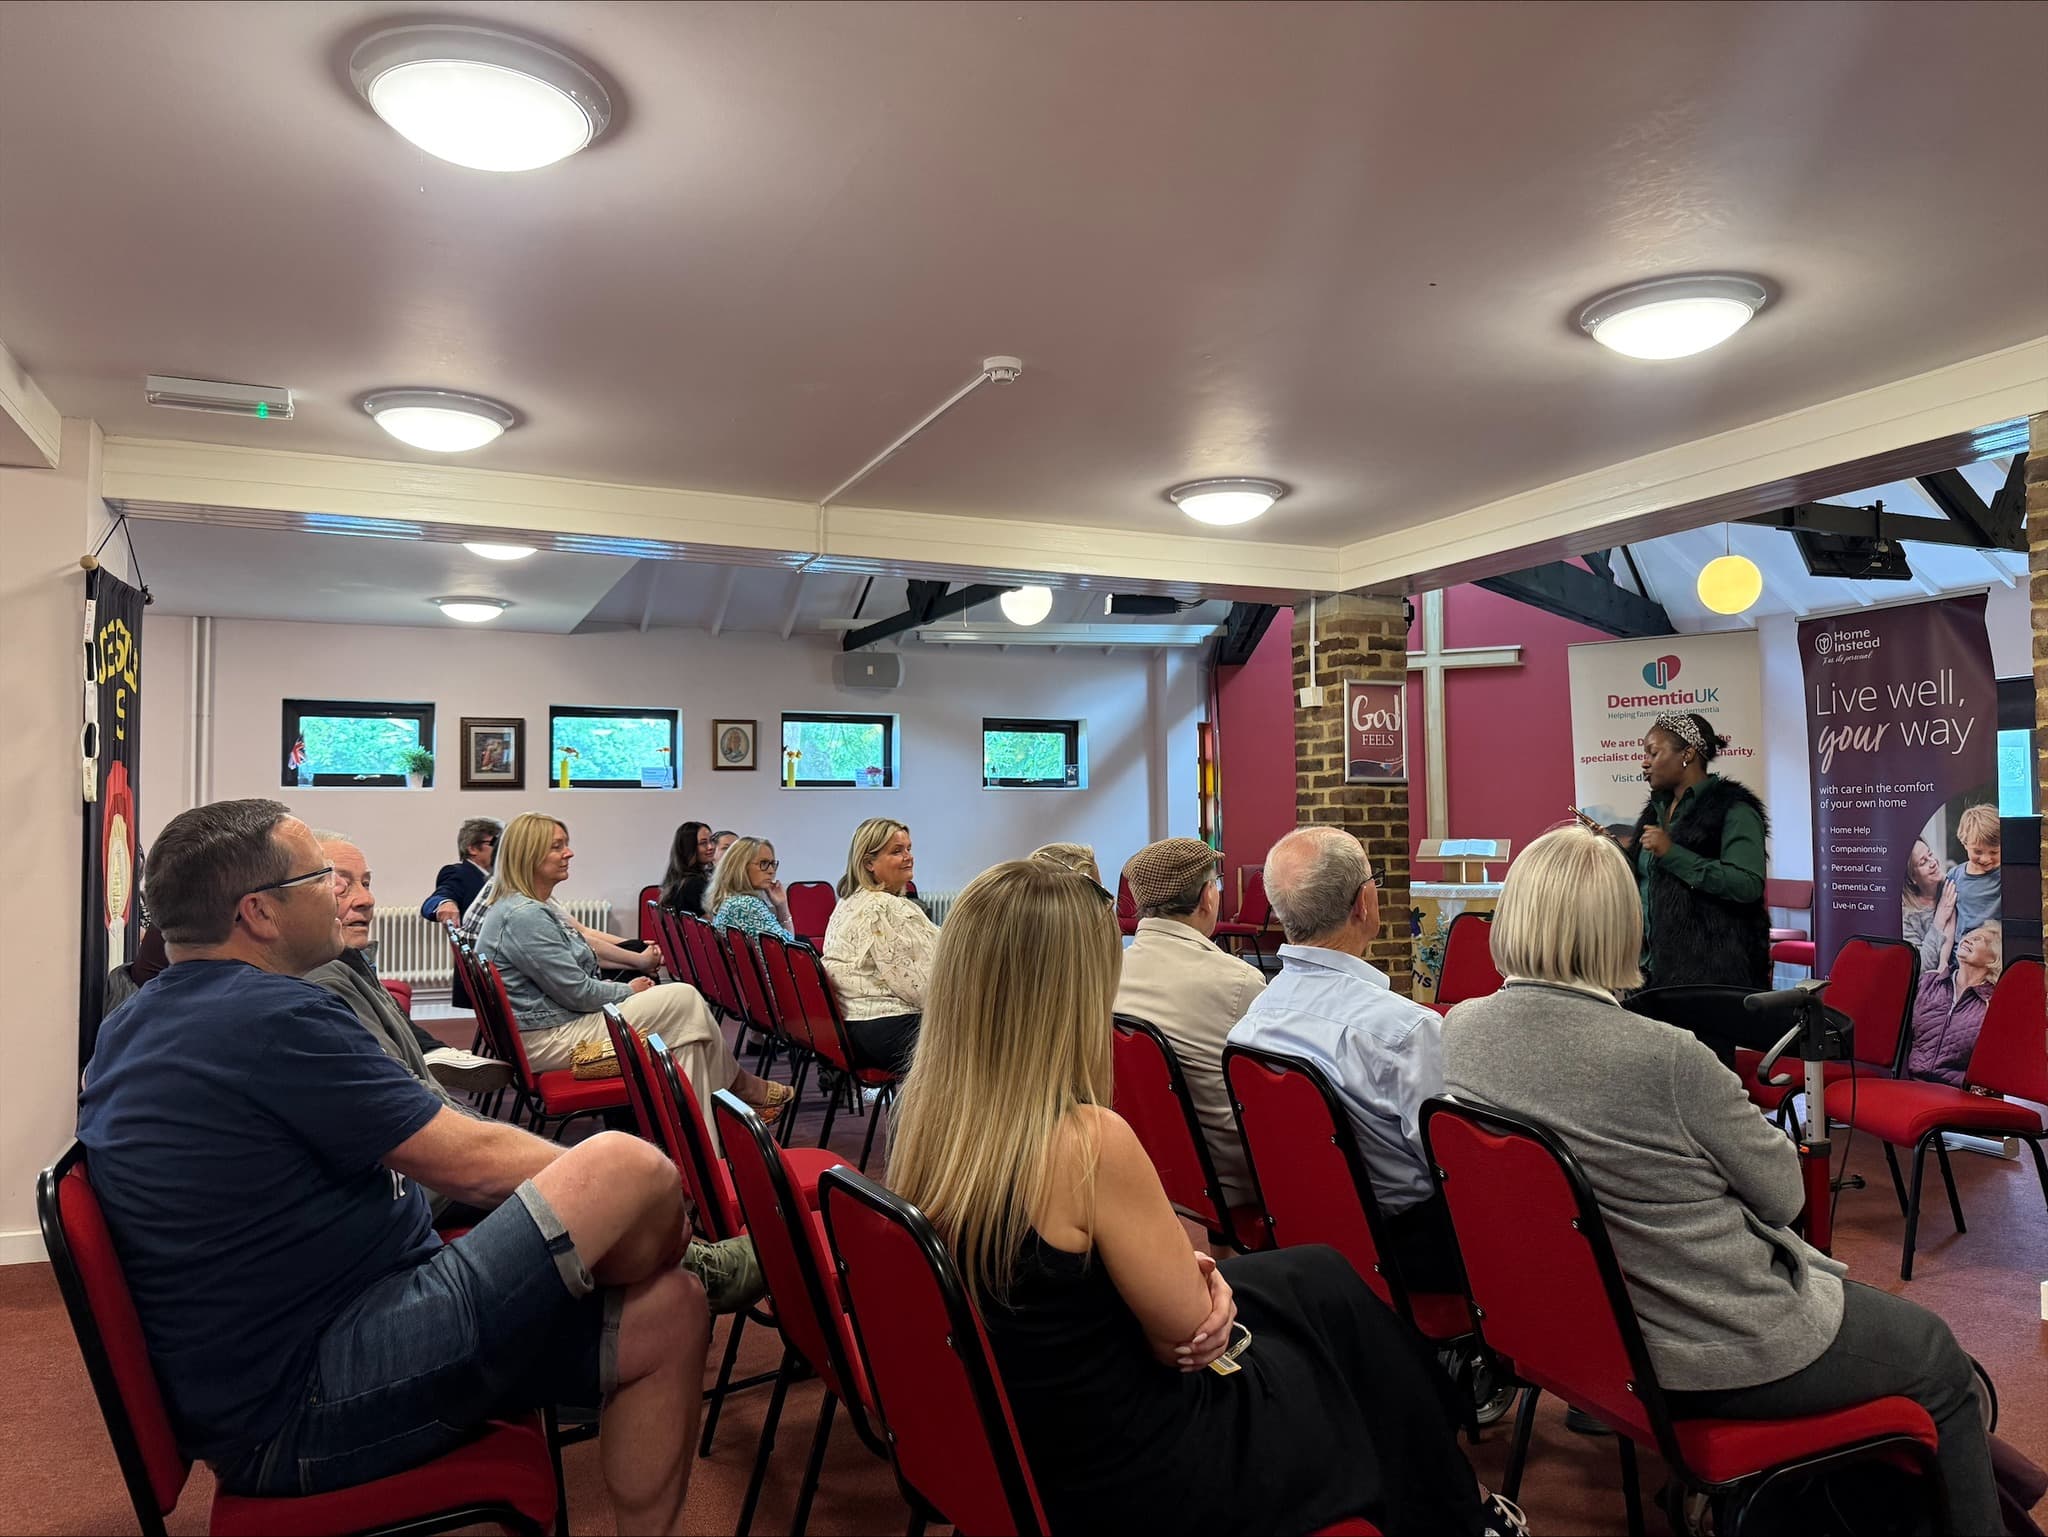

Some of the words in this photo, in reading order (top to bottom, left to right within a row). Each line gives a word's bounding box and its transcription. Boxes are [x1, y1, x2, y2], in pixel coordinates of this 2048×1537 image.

[1834, 629, 1871, 641] Home
[1834, 636, 1880, 653] Instead
[1815, 682, 1877, 716] Live
[1886, 668, 1965, 710] well,
[1352, 694, 1401, 731] God
[1608, 711, 1636, 720] Helping
[1684, 706, 1720, 715] dementia
[1362, 734, 1394, 746] FEELS
[1601, 739, 1617, 748] We
[1618, 740, 1635, 748] are
[1817, 720, 1890, 775] your
[1900, 716, 1975, 755] way
[1580, 752, 1630, 765] specialist
[1611, 773, 1634, 783] Visit
[1819, 784, 1838, 794] with
[1840, 785, 1862, 794] care
[1864, 784, 1874, 793] in
[1876, 783, 1891, 793] the
[1893, 782, 1934, 793] comfort
[1820, 798, 1829, 809] of
[1829, 799, 1854, 812] your
[1855, 799, 1876, 808] own
[1878, 797, 1907, 808] home
[1830, 826, 1852, 834] Home
[1853, 826, 1871, 836] Help
[1830, 845, 1888, 855] Companionship
[1831, 864, 1864, 873] Personal
[1865, 864, 1882, 873] Care
[1832, 882, 1868, 891] Dementia
[1869, 883, 1887, 892] Care
[1832, 902, 1857, 910] Live-in
[1857, 902, 1875, 911] Care
